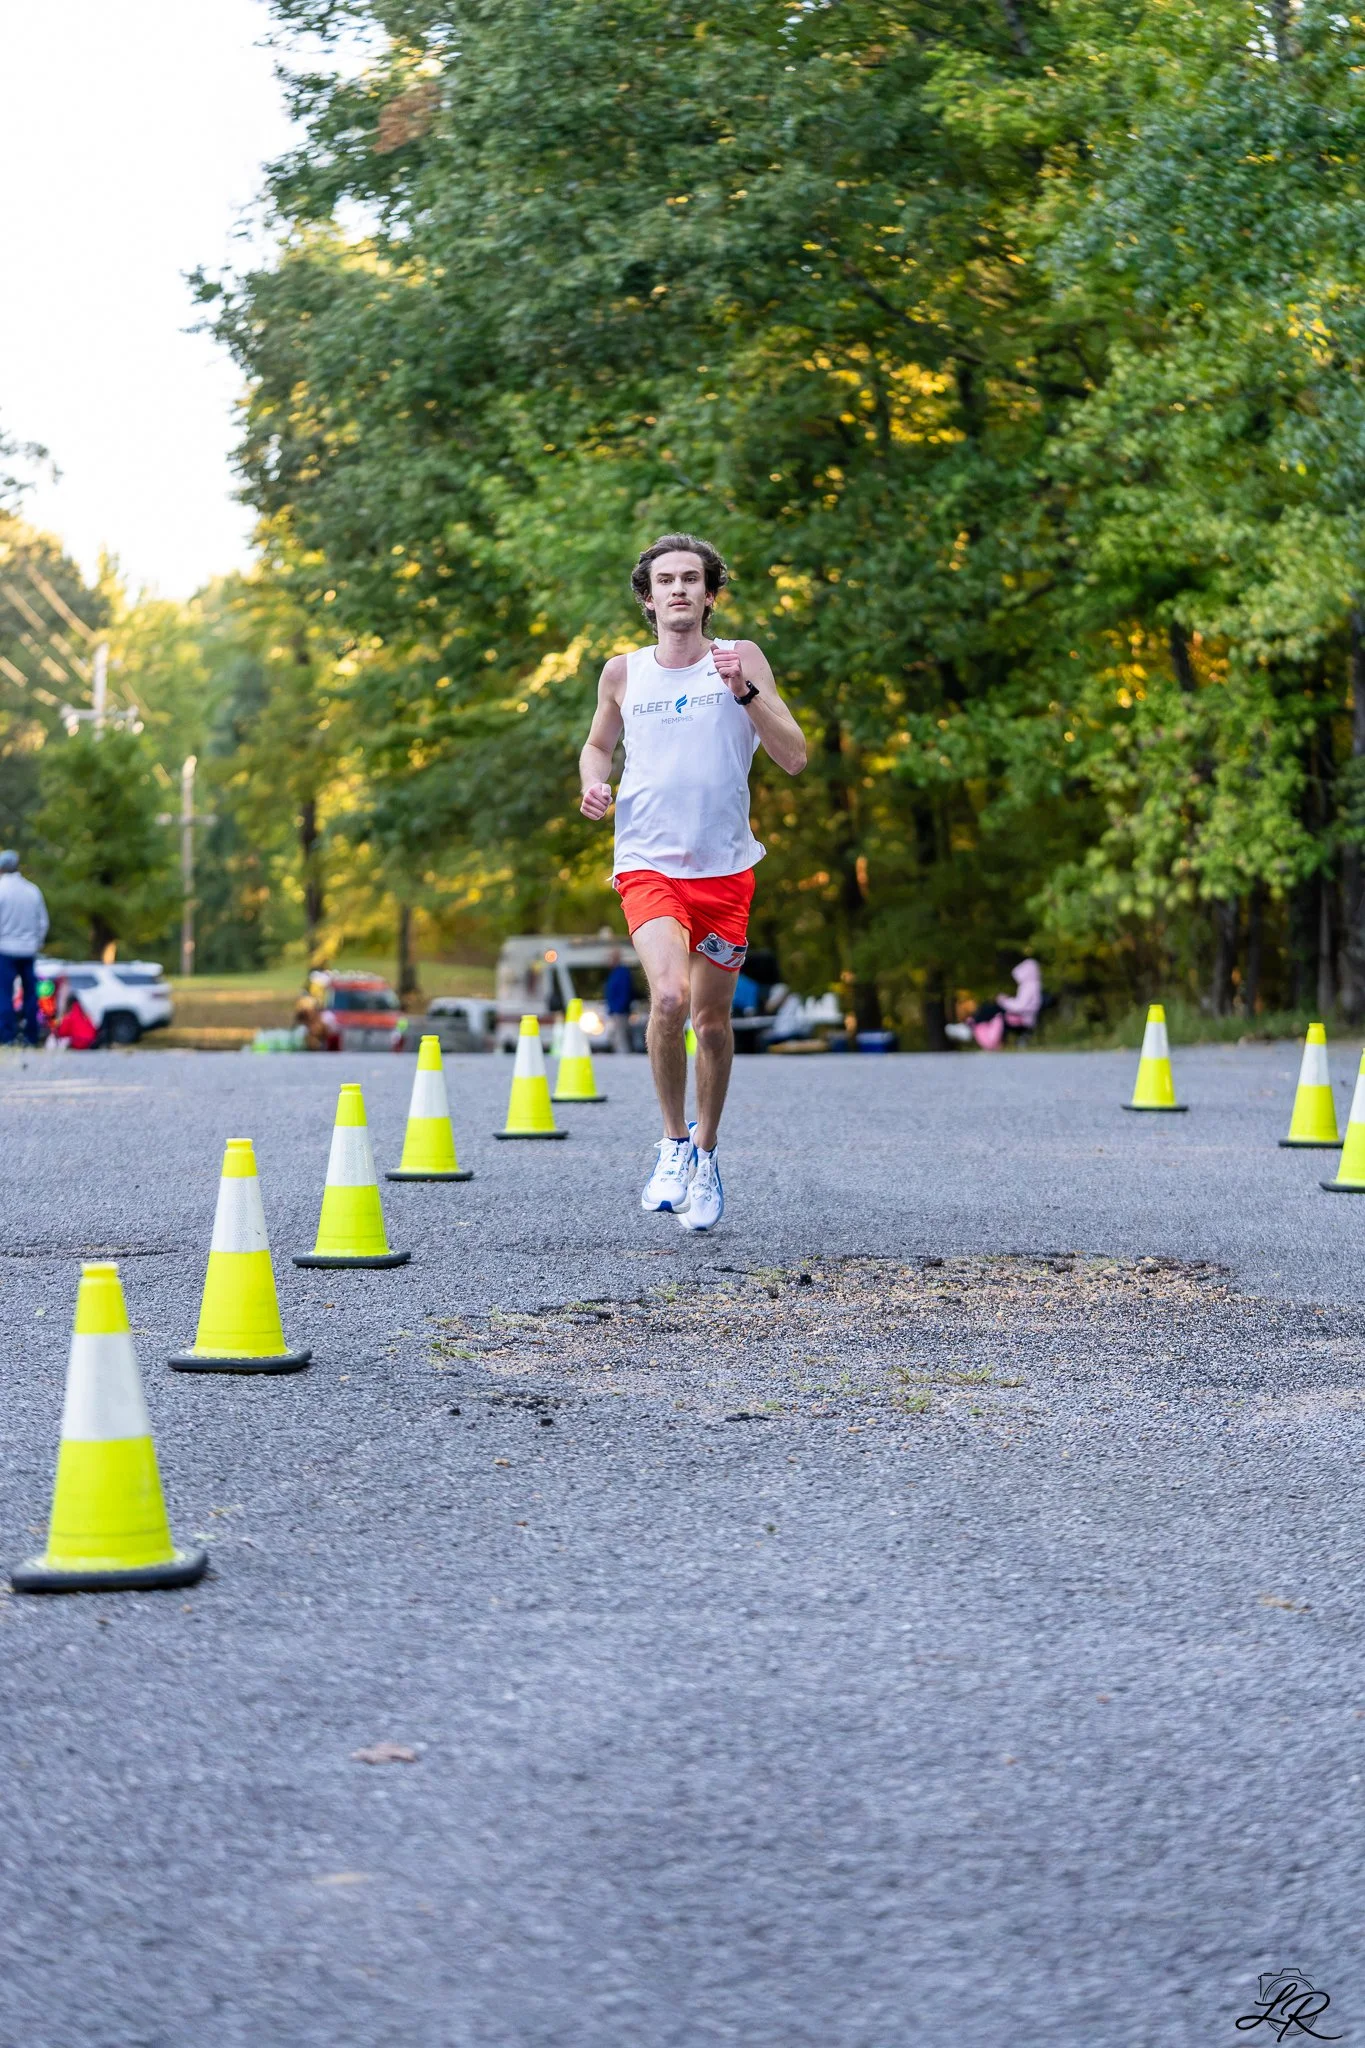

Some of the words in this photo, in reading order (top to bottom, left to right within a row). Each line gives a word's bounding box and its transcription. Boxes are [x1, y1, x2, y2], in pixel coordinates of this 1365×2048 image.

[632, 700, 672, 715] FLEET
[690, 692, 723, 707] FEET
[661, 715, 693, 724] MEMPHIS
